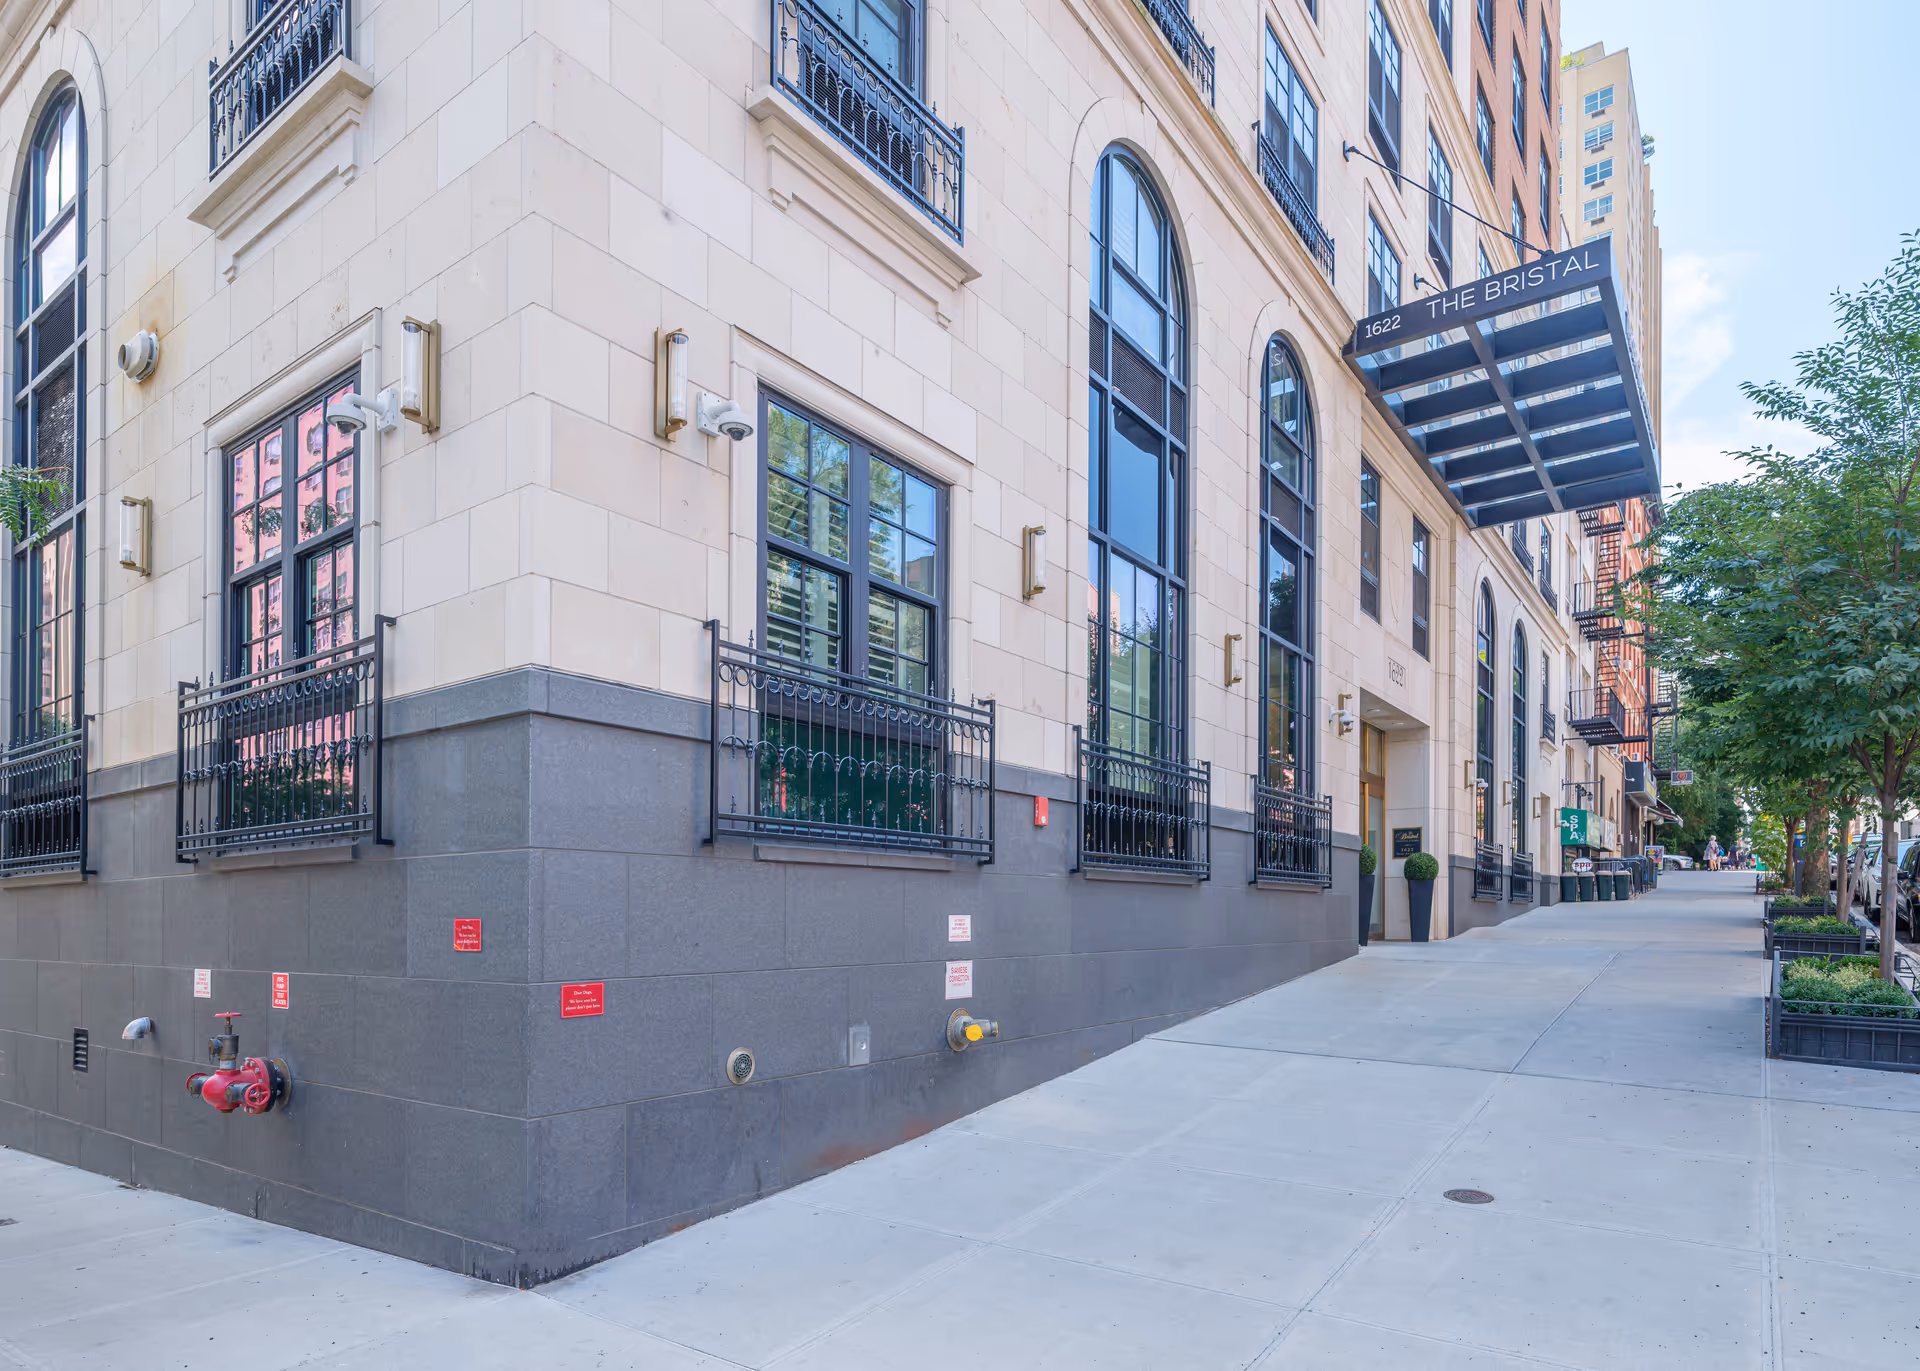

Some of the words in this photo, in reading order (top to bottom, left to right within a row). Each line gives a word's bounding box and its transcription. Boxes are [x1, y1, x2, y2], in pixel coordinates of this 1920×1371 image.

[1365, 315, 1401, 339] 1622
[1426, 287, 1475, 319] THE
[1484, 250, 1600, 302] BRISTAL
[1388, 660, 1404, 687] 1622
[1569, 815, 1578, 840] SPA
[948, 974, 970, 983] CONNECTION
